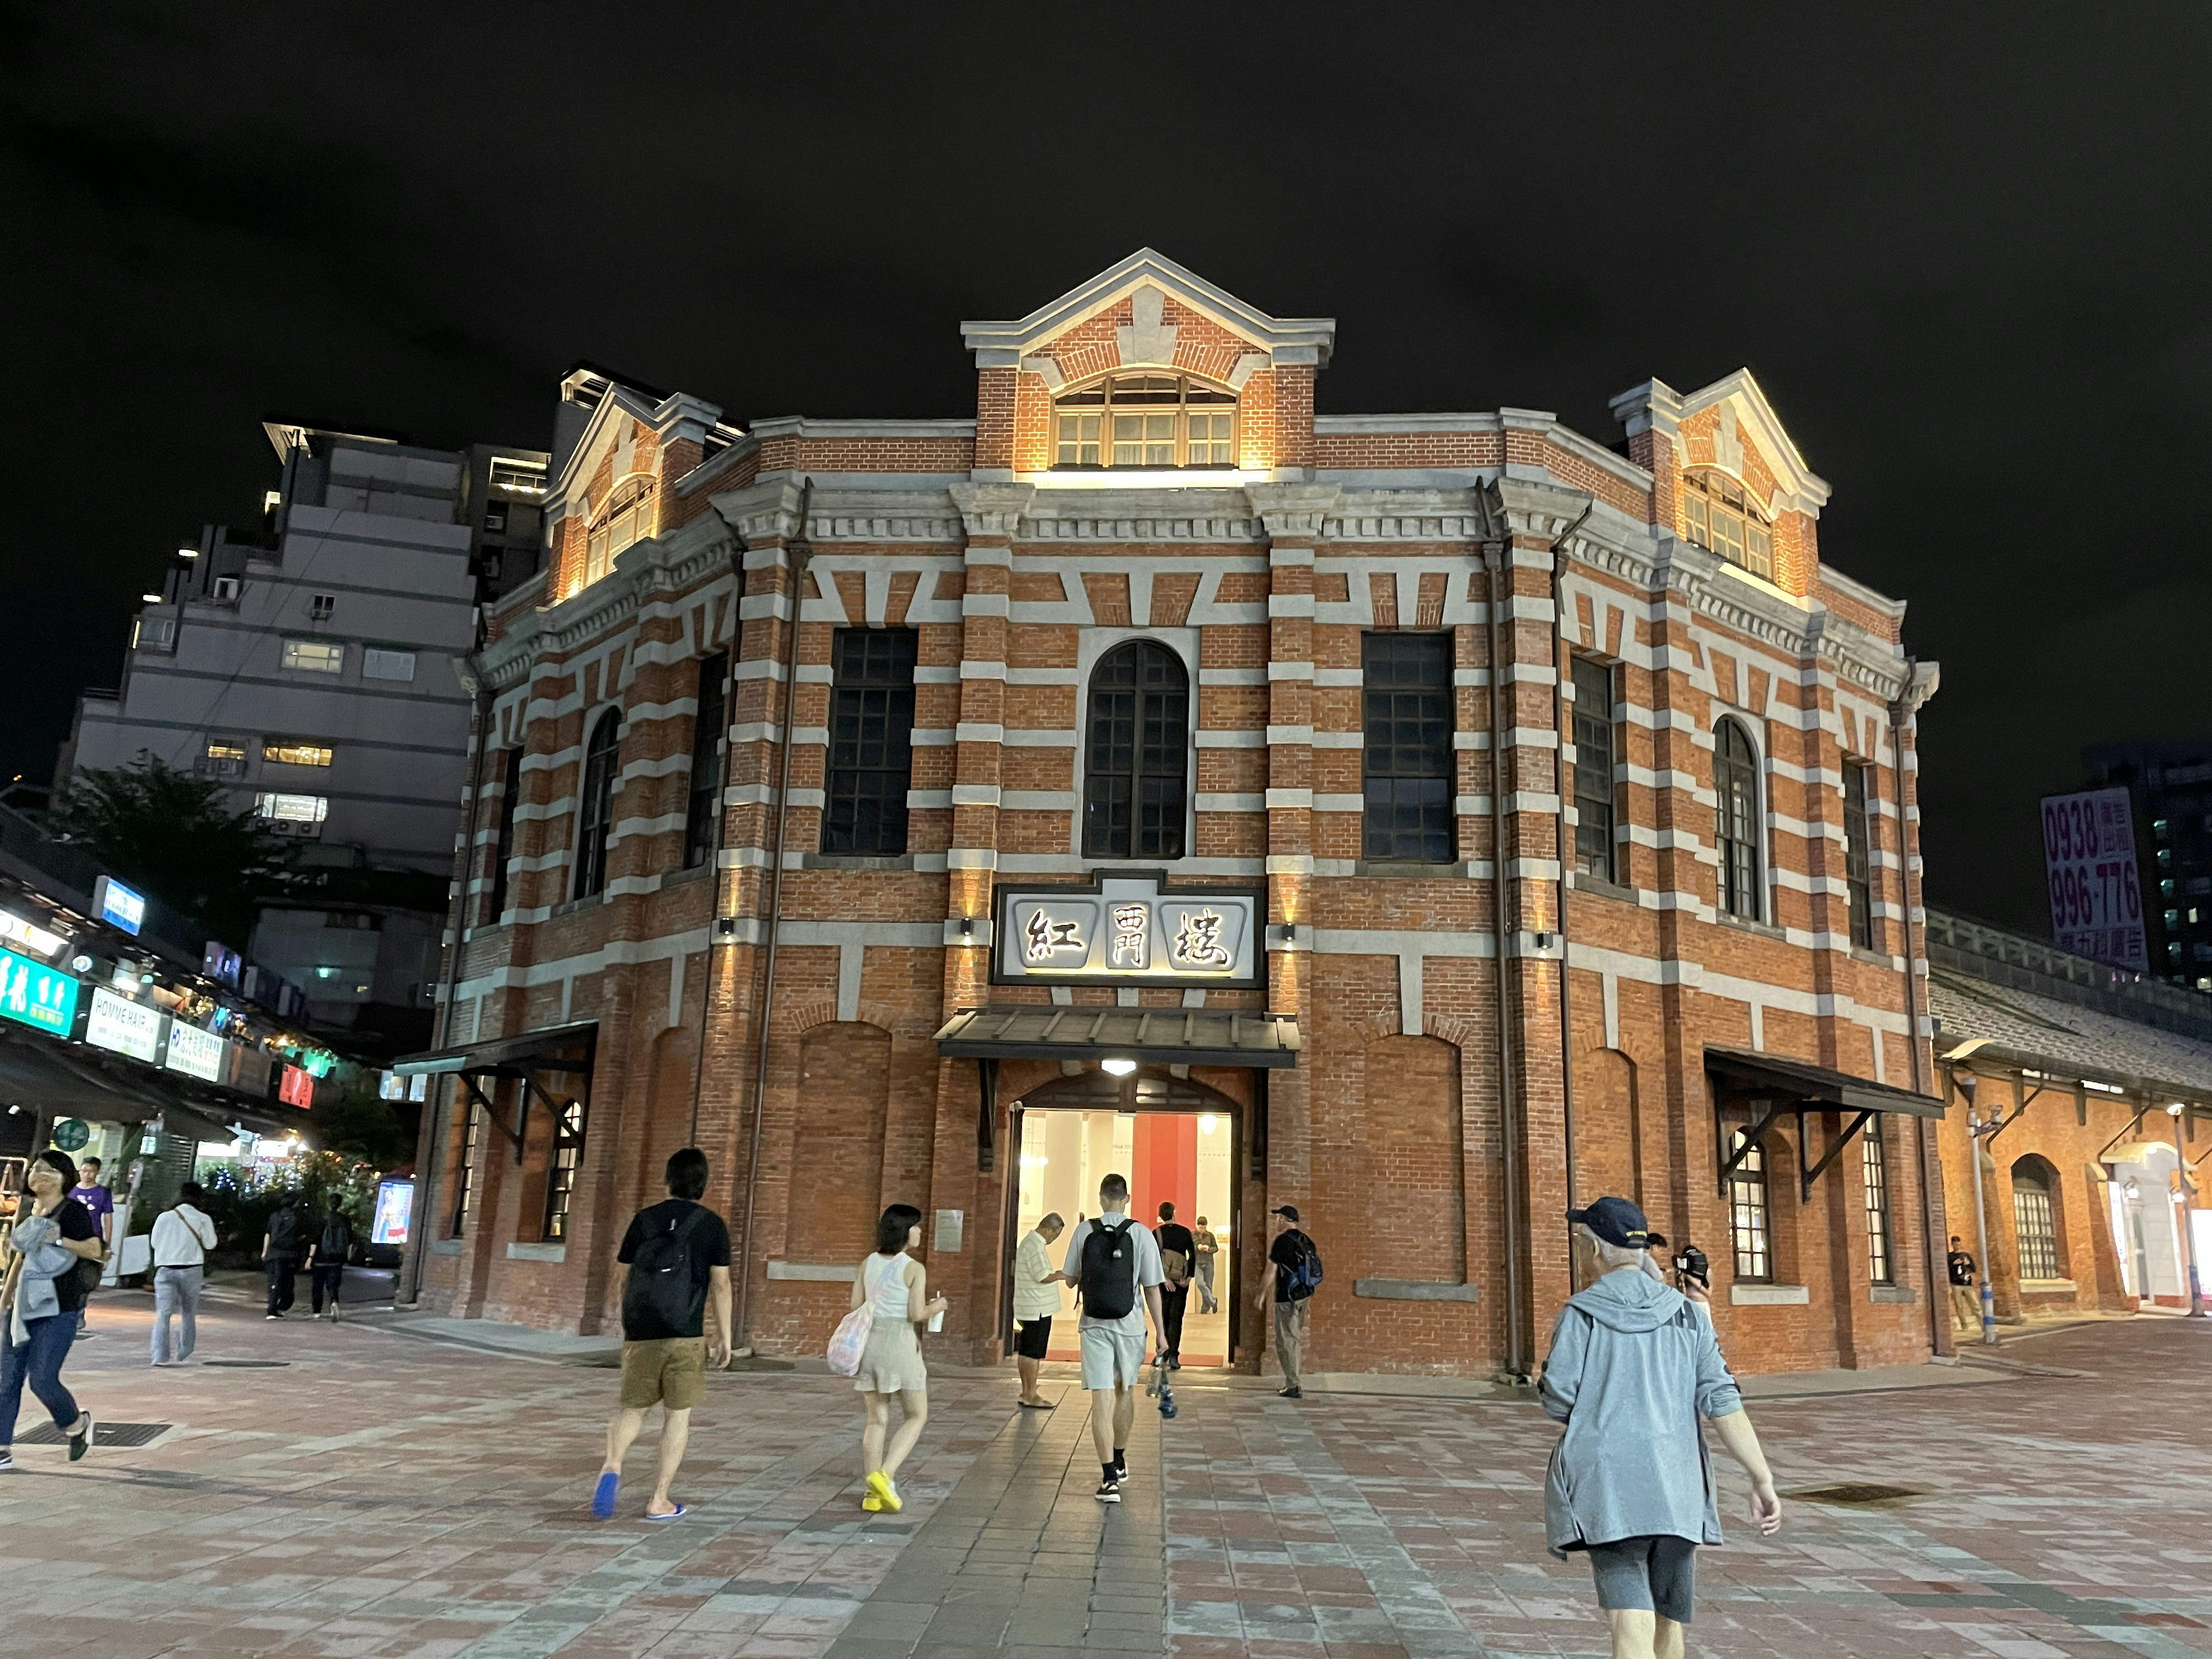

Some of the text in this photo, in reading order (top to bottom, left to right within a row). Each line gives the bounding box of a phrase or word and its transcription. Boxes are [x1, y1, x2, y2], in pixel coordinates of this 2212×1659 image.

[2045, 799, 2098, 861] 0938
[1026, 908, 1086, 961] 紅
[1113, 905, 1146, 968] 西門
[96, 997, 146, 1030] HOMME HAIR
